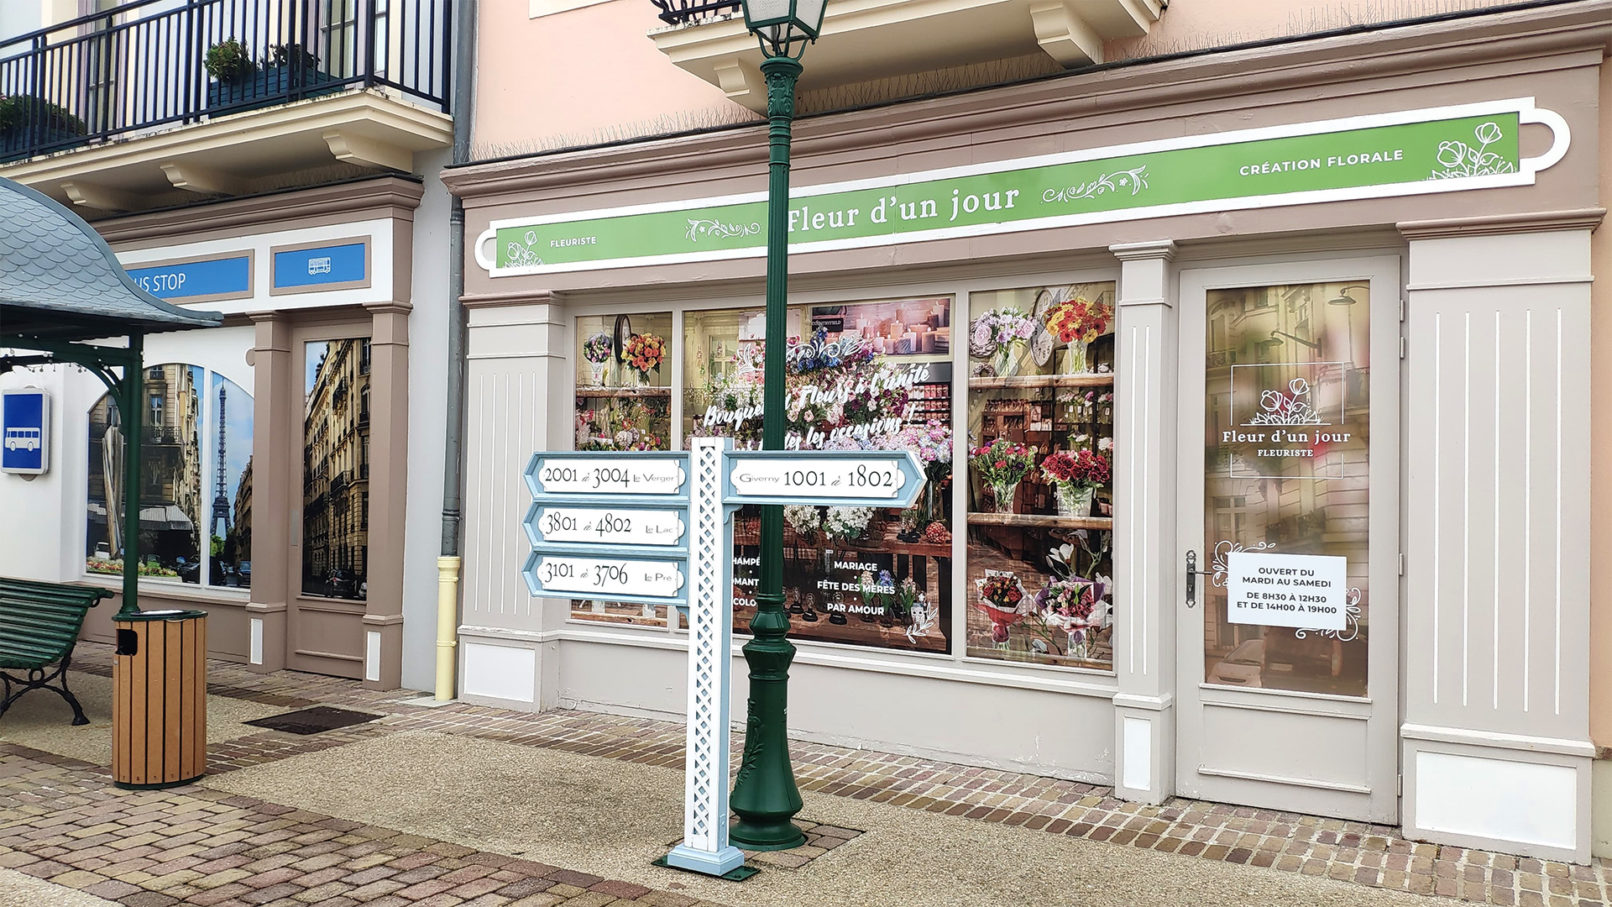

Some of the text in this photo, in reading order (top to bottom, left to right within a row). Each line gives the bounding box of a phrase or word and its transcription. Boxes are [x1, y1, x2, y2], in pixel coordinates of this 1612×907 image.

[1239, 149, 1404, 177] CRÉATION FLORALE
[788, 206, 859, 232] Fleur
[950, 188, 1020, 221] jour
[550, 236, 597, 248] FLEURISTE
[134, 273, 186, 292] US STOP
[806, 426, 826, 449] les
[830, 418, 902, 440] occasions
[1222, 430, 1266, 443] Fleur
[1314, 430, 1350, 446] jour
[1258, 449, 1313, 457] FLEURISTE
[545, 468, 577, 482] 2001
[582, 472, 590, 482] à
[592, 468, 630, 488] 3004
[643, 473, 674, 483] Verger
[739, 464, 893, 487] Giverny 1001 à 1802
[545, 512, 577, 534] 3801
[583, 521, 592, 531] à
[595, 513, 631, 537] 4802
[656, 525, 673, 534] Lac
[834, 561, 878, 571] MARIAGE
[1258, 567, 1297, 576] OUVERT
[545, 563, 574, 583] 3101
[580, 568, 589, 578] à
[593, 563, 628, 587] 3706
[817, 579, 839, 590] FÊTE
[842, 583, 860, 592] DES
[1277, 578, 1290, 586] AU
[1293, 579, 1331, 588] SAMEDI
[1262, 593, 1286, 601] 8H30
[1289, 591, 1296, 601] À
[1299, 594, 1327, 603] 12H30
[827, 603, 884, 616] PAR AMOUR
[1266, 602, 1296, 611] 14H00
[1298, 602, 1305, 612] À
[1307, 605, 1337, 614] 19H00
